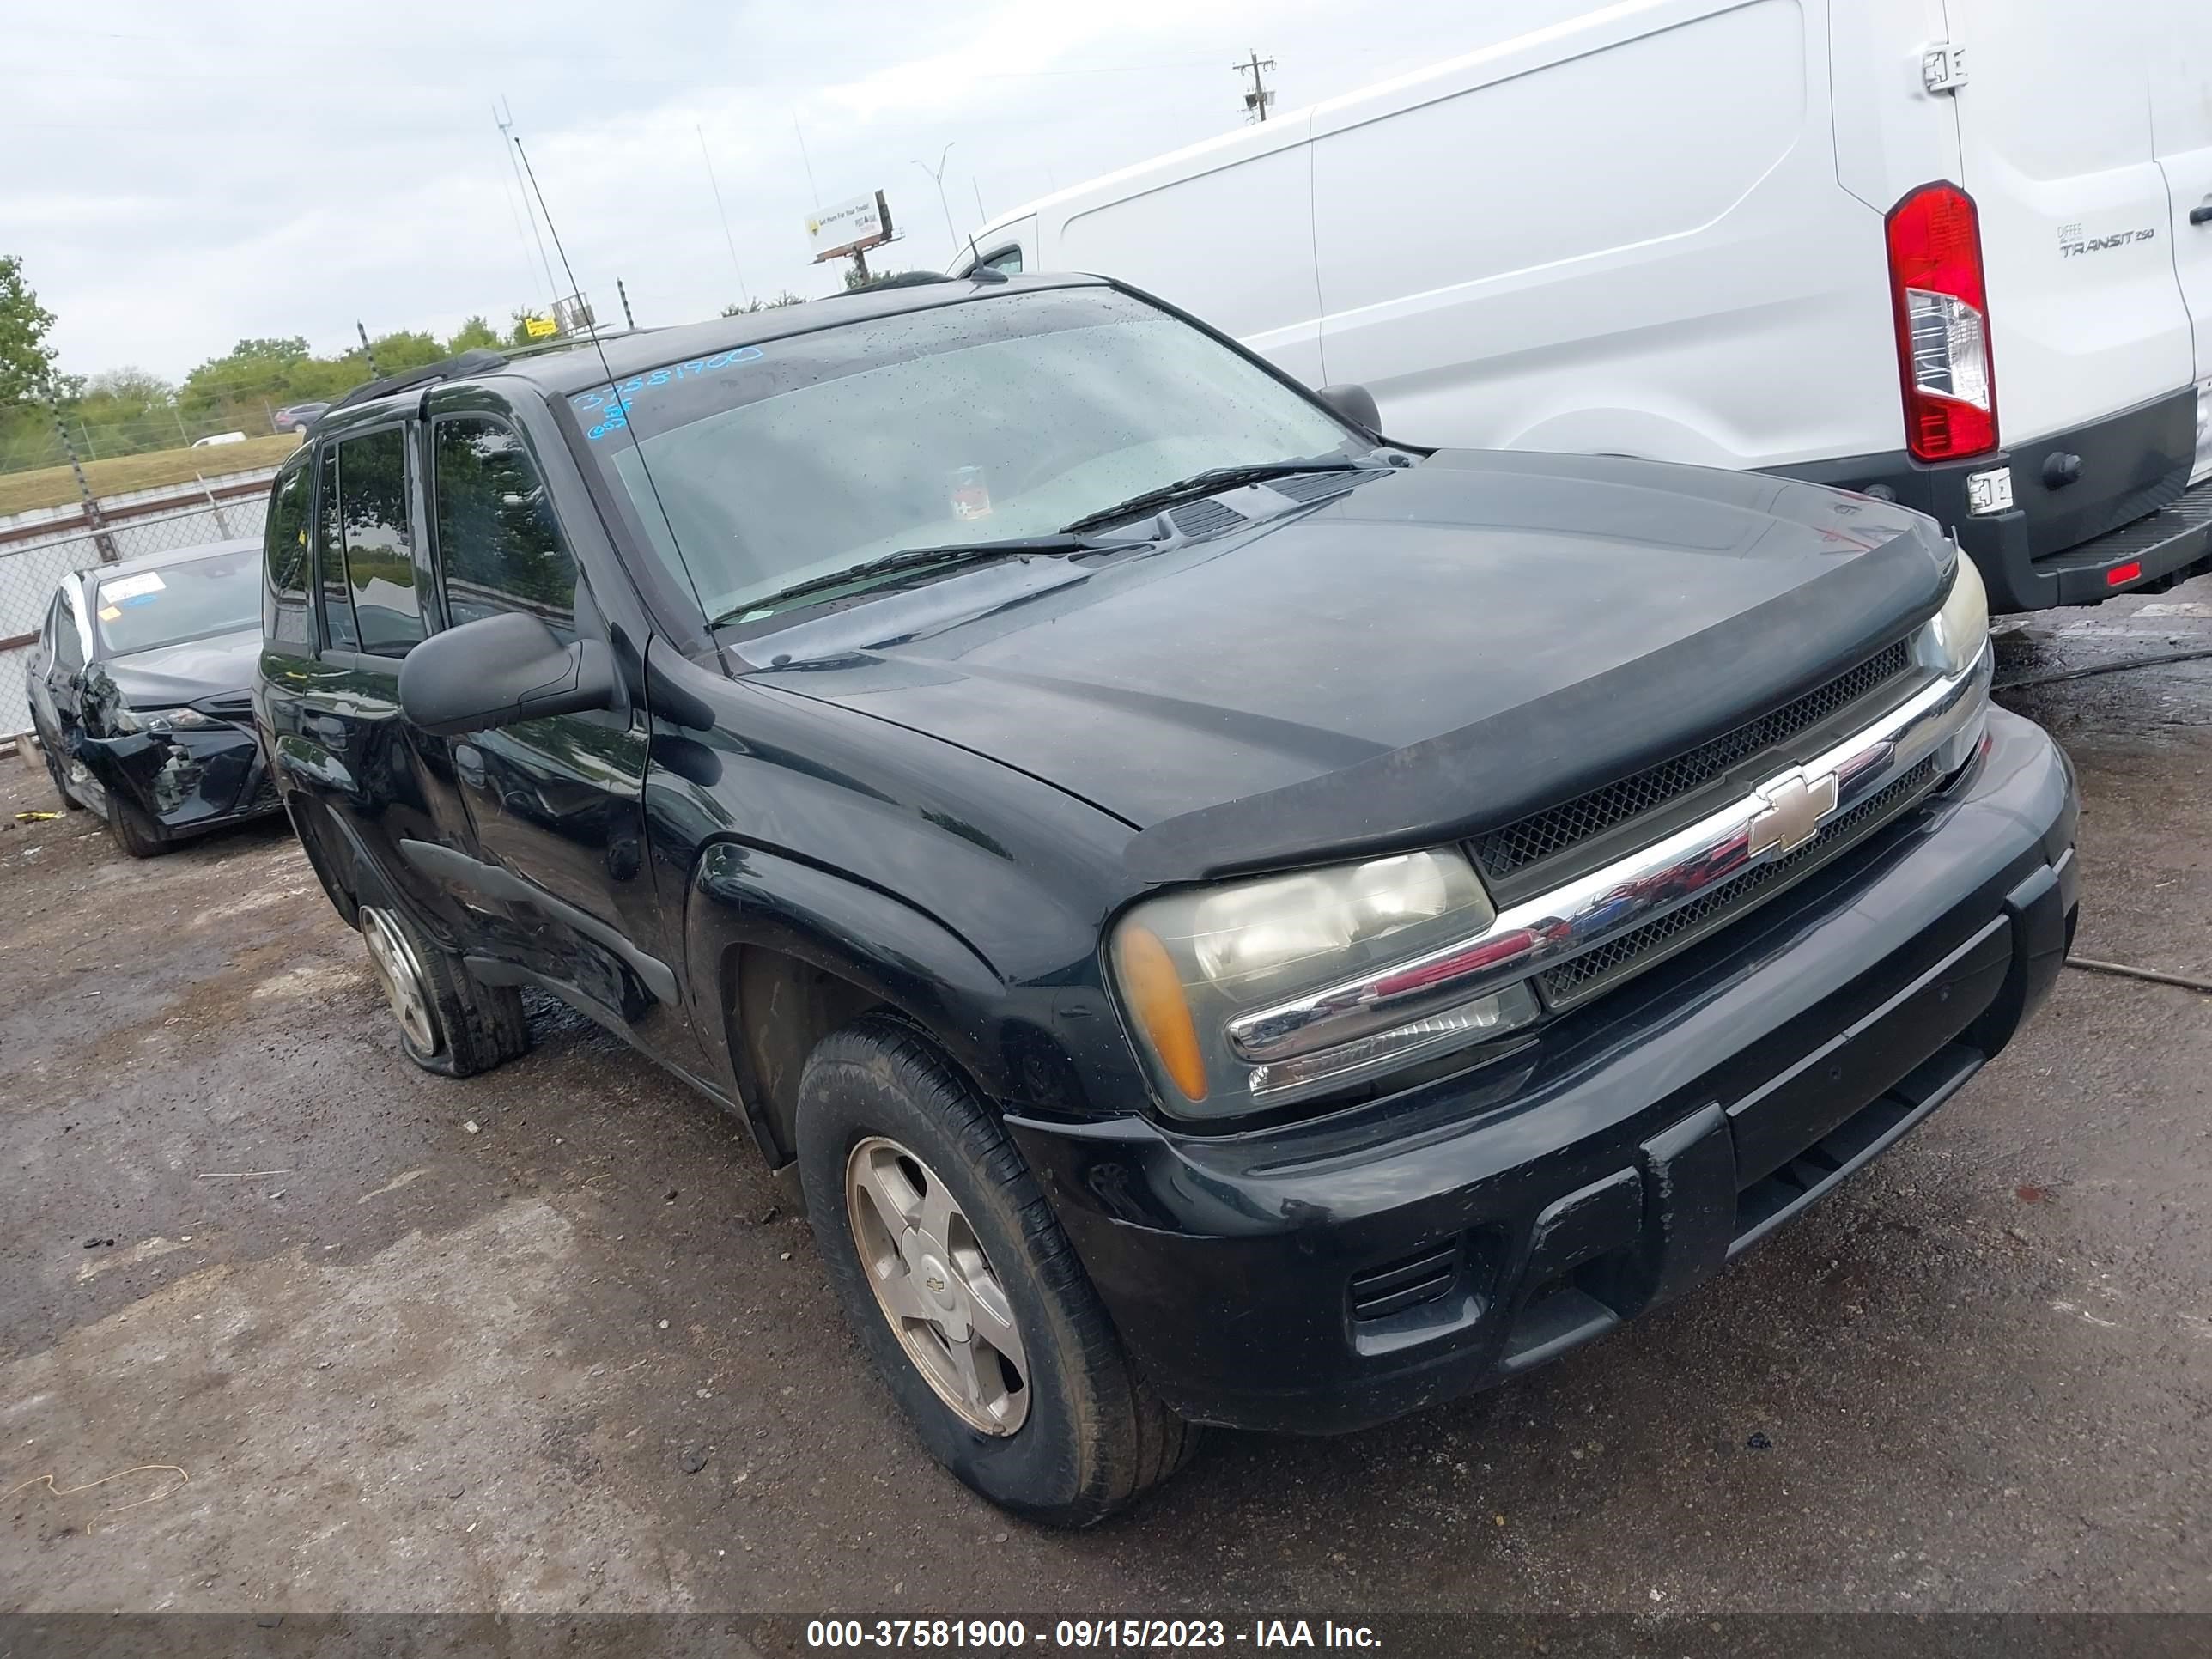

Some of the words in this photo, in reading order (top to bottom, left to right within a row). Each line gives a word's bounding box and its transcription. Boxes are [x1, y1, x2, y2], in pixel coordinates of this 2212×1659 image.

[2060, 230, 2134, 258] TRANSIT
[2135, 228, 2155, 241] 250
[574, 347, 763, 410] 37581900
